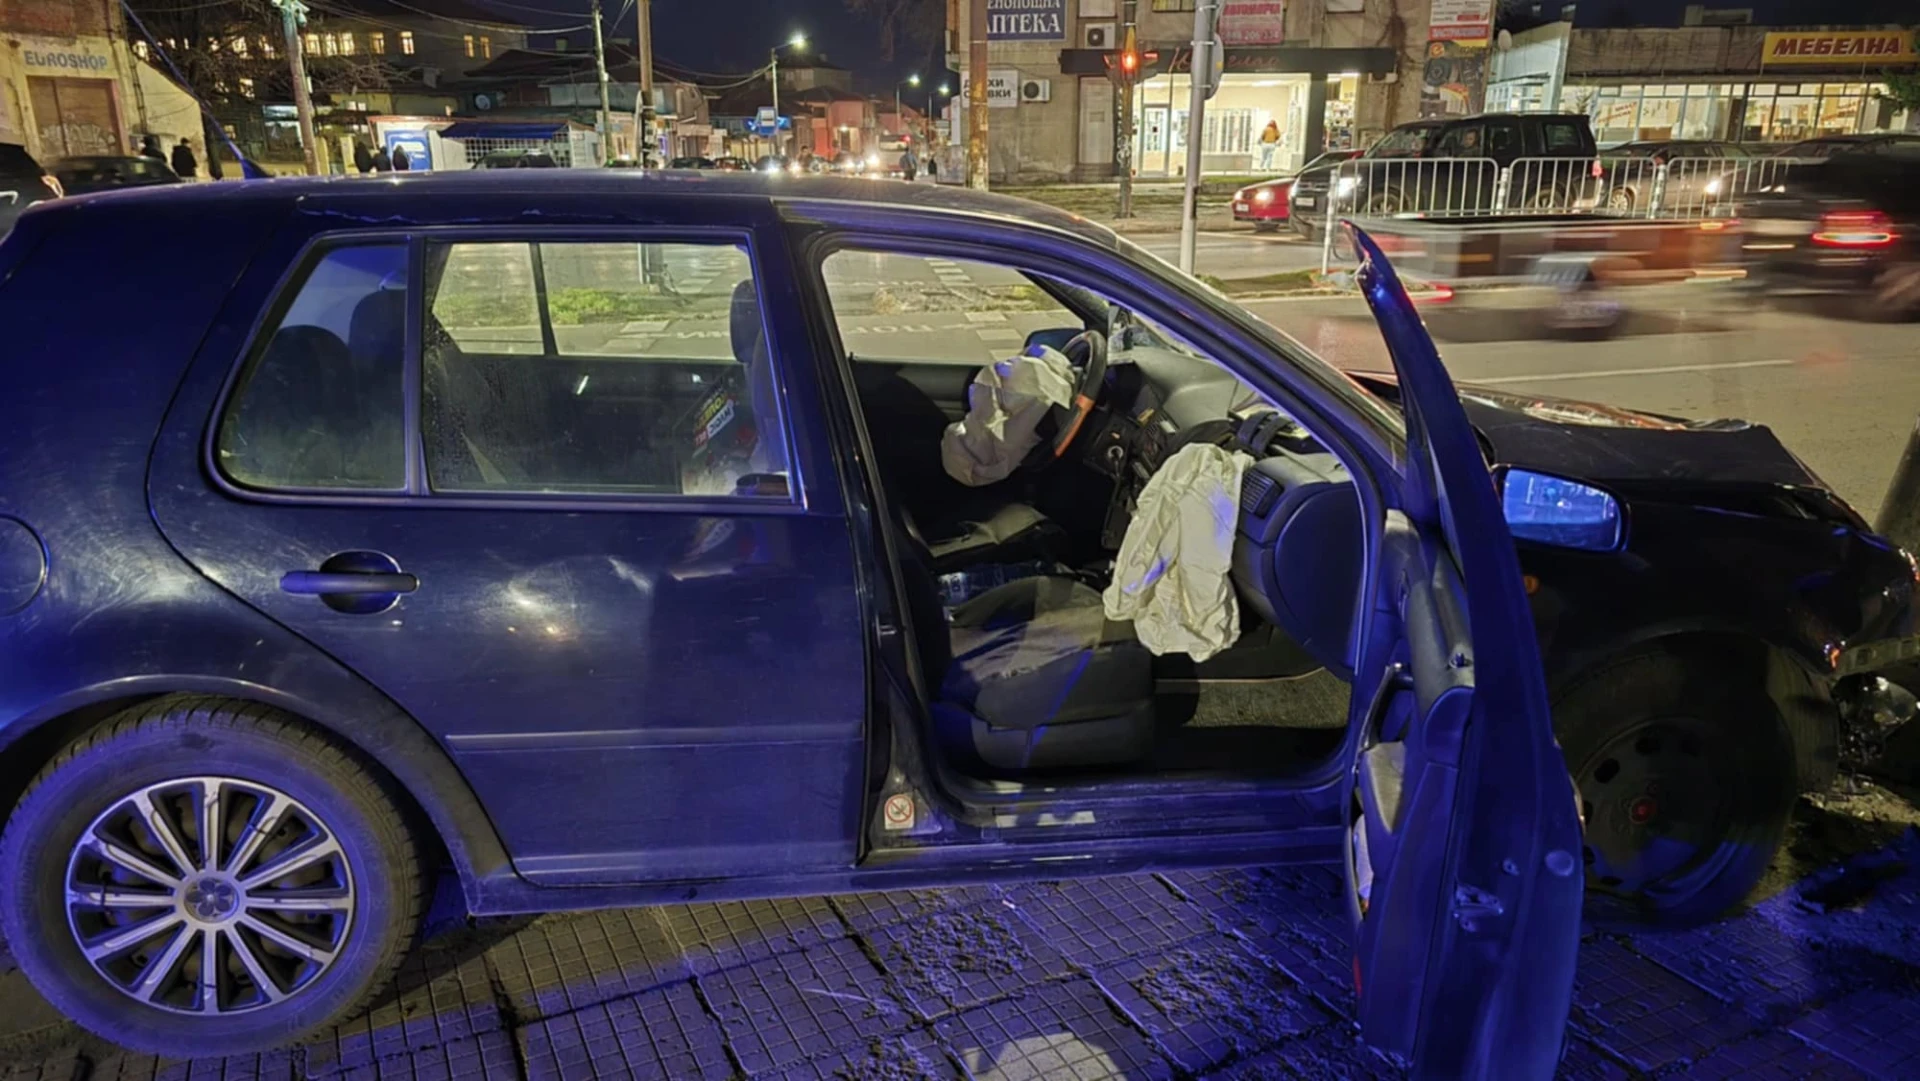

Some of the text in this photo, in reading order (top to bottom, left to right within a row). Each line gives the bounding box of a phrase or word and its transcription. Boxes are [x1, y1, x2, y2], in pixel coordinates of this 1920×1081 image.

[986, 0, 1061, 9] ЕНОНОЩНА
[986, 13, 1061, 34] ПТЕКА
[1772, 37, 1901, 55] МЕБЕЛНА
[24, 51, 108, 70] EUROSHOP
